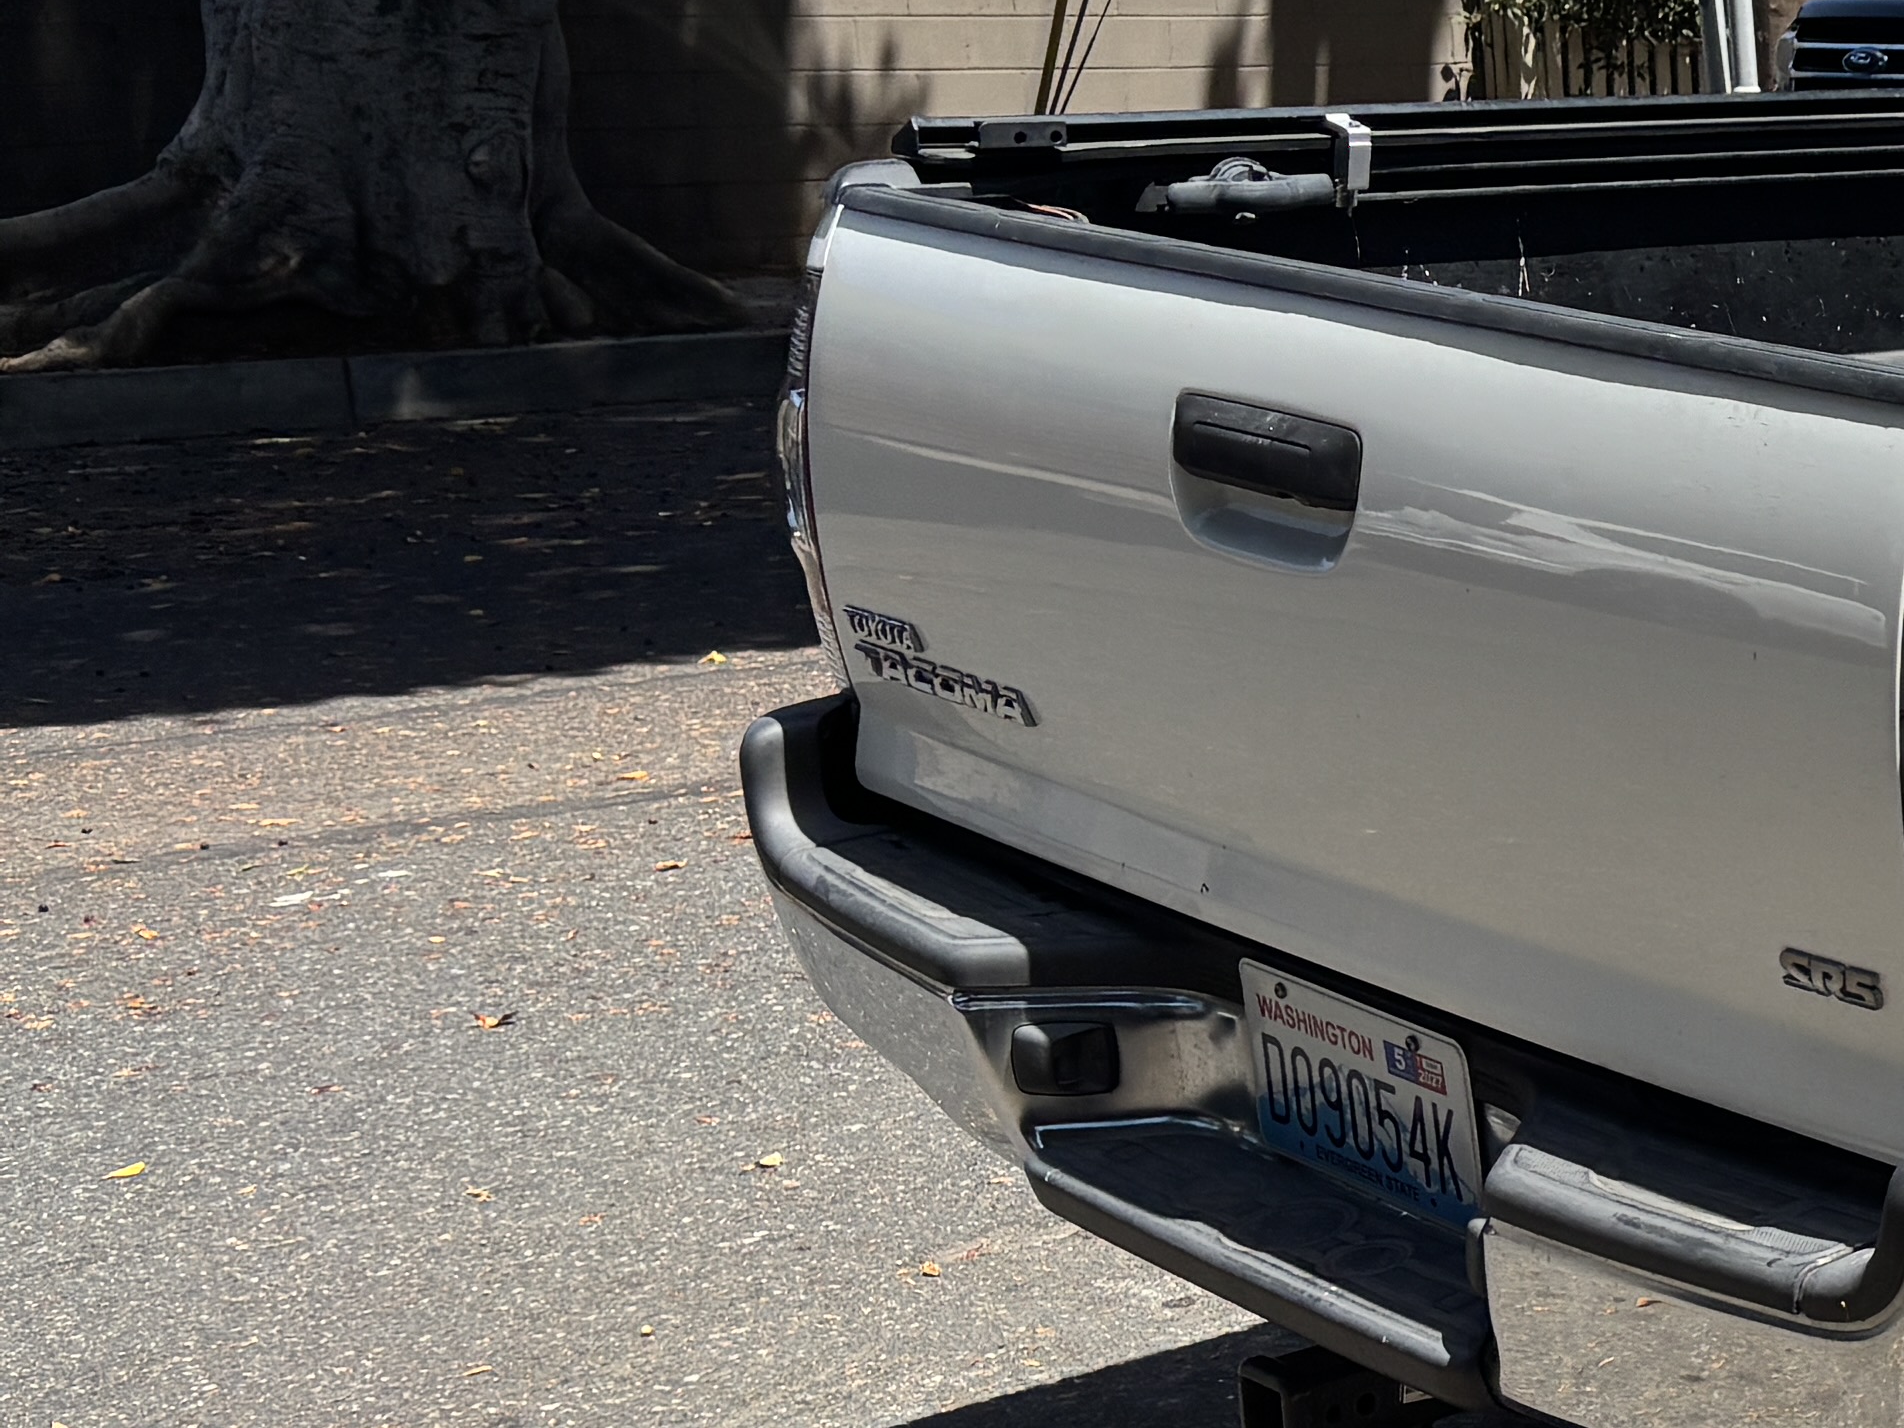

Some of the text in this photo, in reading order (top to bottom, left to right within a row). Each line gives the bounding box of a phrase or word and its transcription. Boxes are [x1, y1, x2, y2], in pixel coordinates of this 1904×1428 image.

[843, 605, 925, 653] TOYOTA
[855, 639, 1038, 728] TACOMA
[1779, 947, 1884, 1011] SR5
[1255, 992, 1375, 1062] WASHINGTON
[1393, 1046, 1406, 1071] 5
[1261, 1031, 1463, 1203] D09054K
[1315, 1144, 1421, 1202] EVERGREEN STATE
